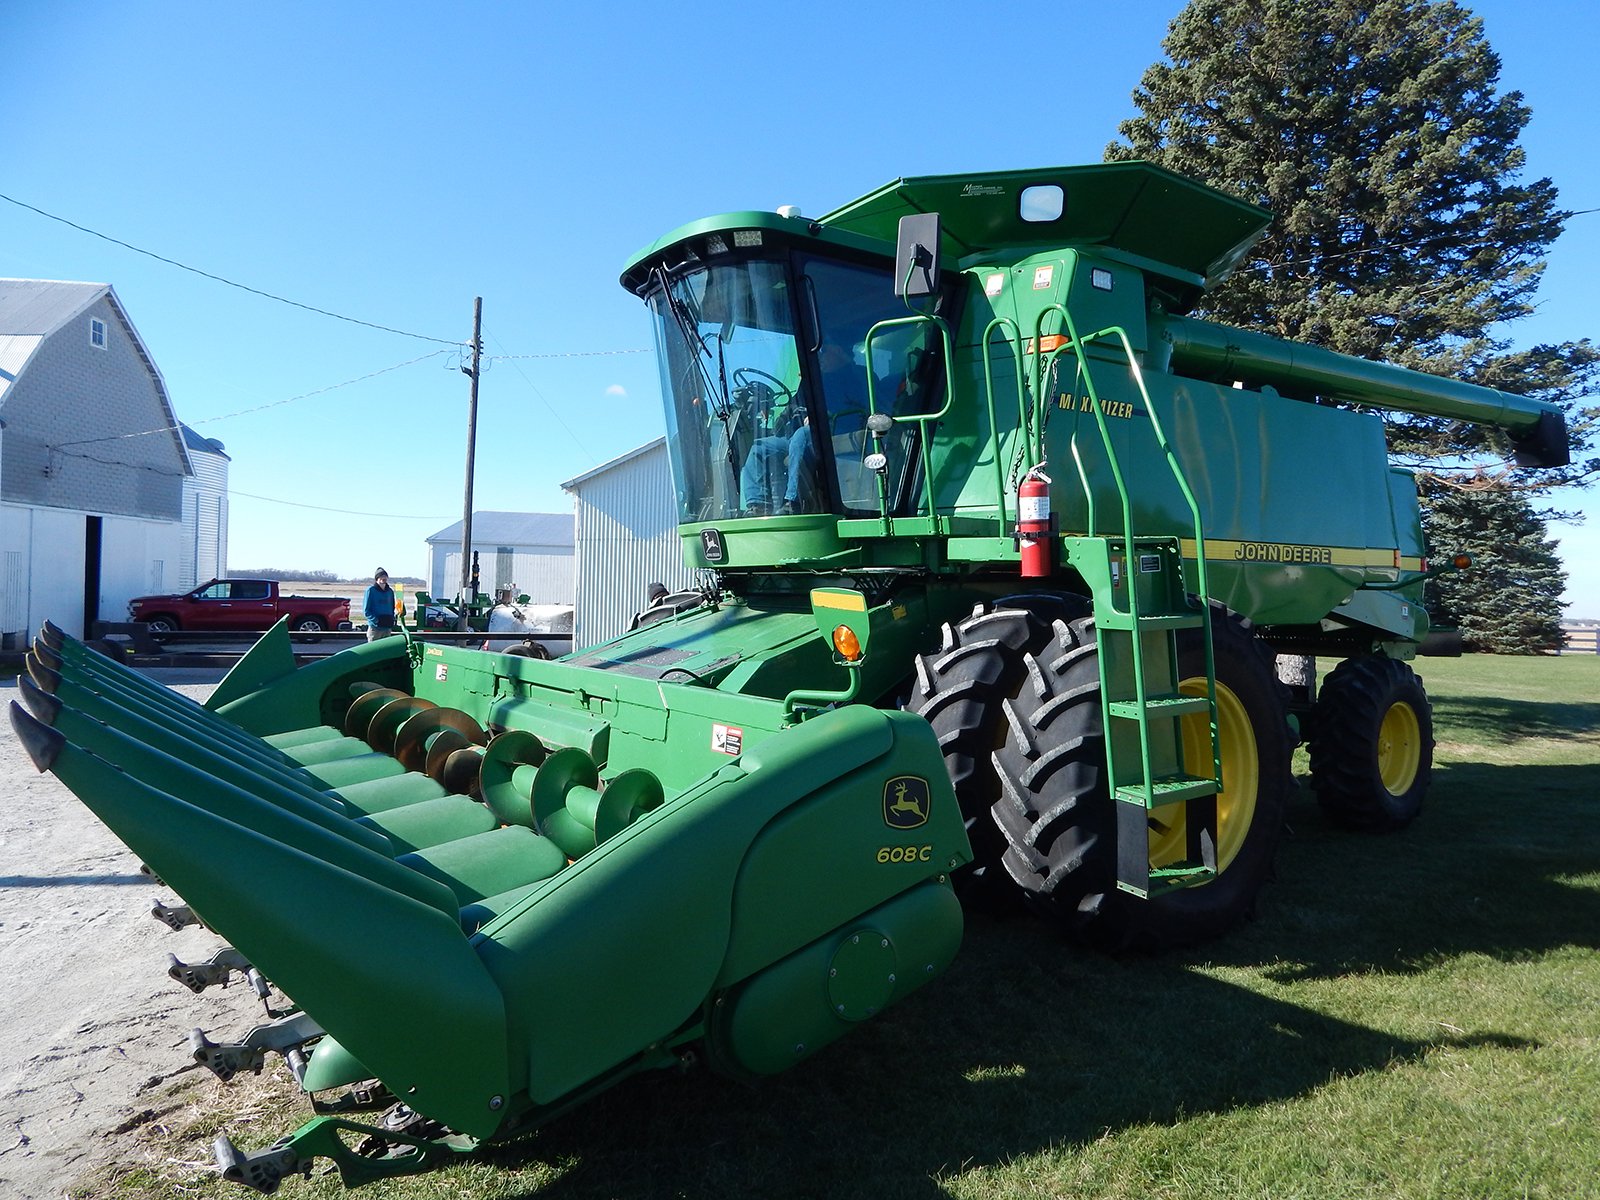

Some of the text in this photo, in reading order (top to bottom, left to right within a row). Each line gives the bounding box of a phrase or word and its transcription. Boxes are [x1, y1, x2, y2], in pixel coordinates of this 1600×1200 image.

[1235, 543, 1331, 563] JOHN DEERE
[877, 846, 932, 863] 608C
